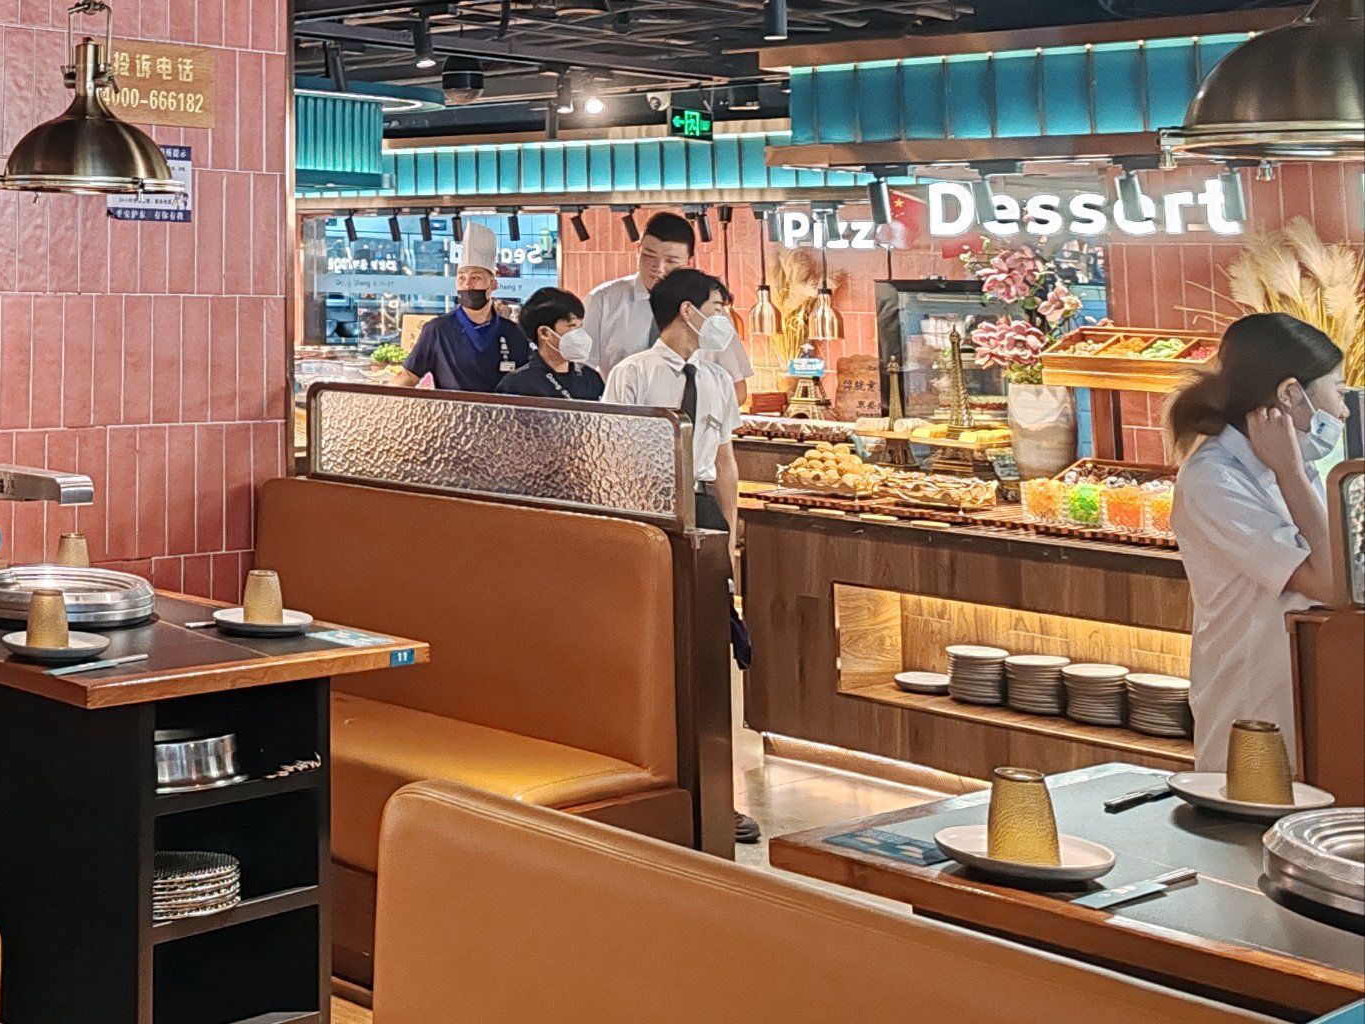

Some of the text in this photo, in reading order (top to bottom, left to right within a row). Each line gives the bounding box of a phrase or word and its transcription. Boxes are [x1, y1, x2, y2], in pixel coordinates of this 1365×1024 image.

[113, 51, 193, 82] 投诉电话
[928, 179, 1242, 236] Dessert
[396, 652, 407, 662] 11
